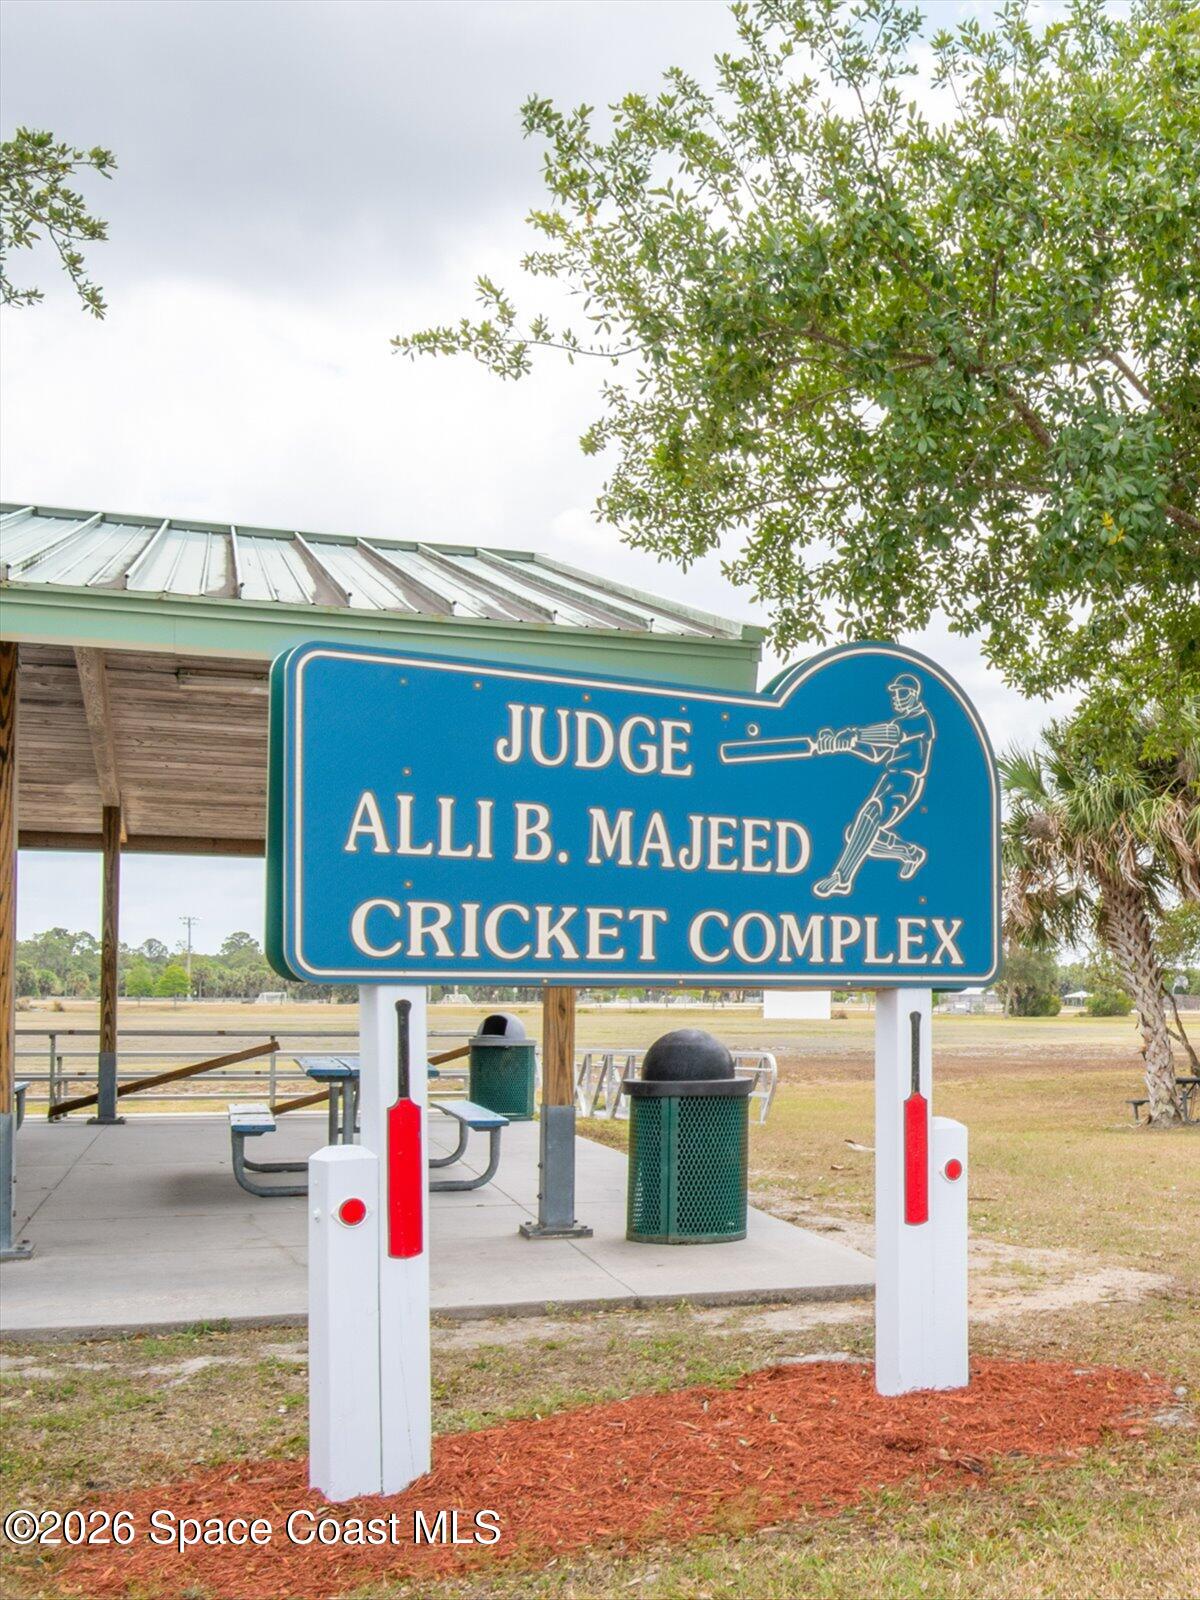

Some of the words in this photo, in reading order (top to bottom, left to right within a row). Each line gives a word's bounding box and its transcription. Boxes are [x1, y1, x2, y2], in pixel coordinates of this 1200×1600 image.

[496, 703, 693, 777] JUDGE
[344, 791, 494, 859] ALLI
[514, 802, 568, 864] B.
[587, 808, 811, 874] MAJEED
[351, 898, 668, 961] CRICKET
[689, 910, 964, 965] COMPLEX
